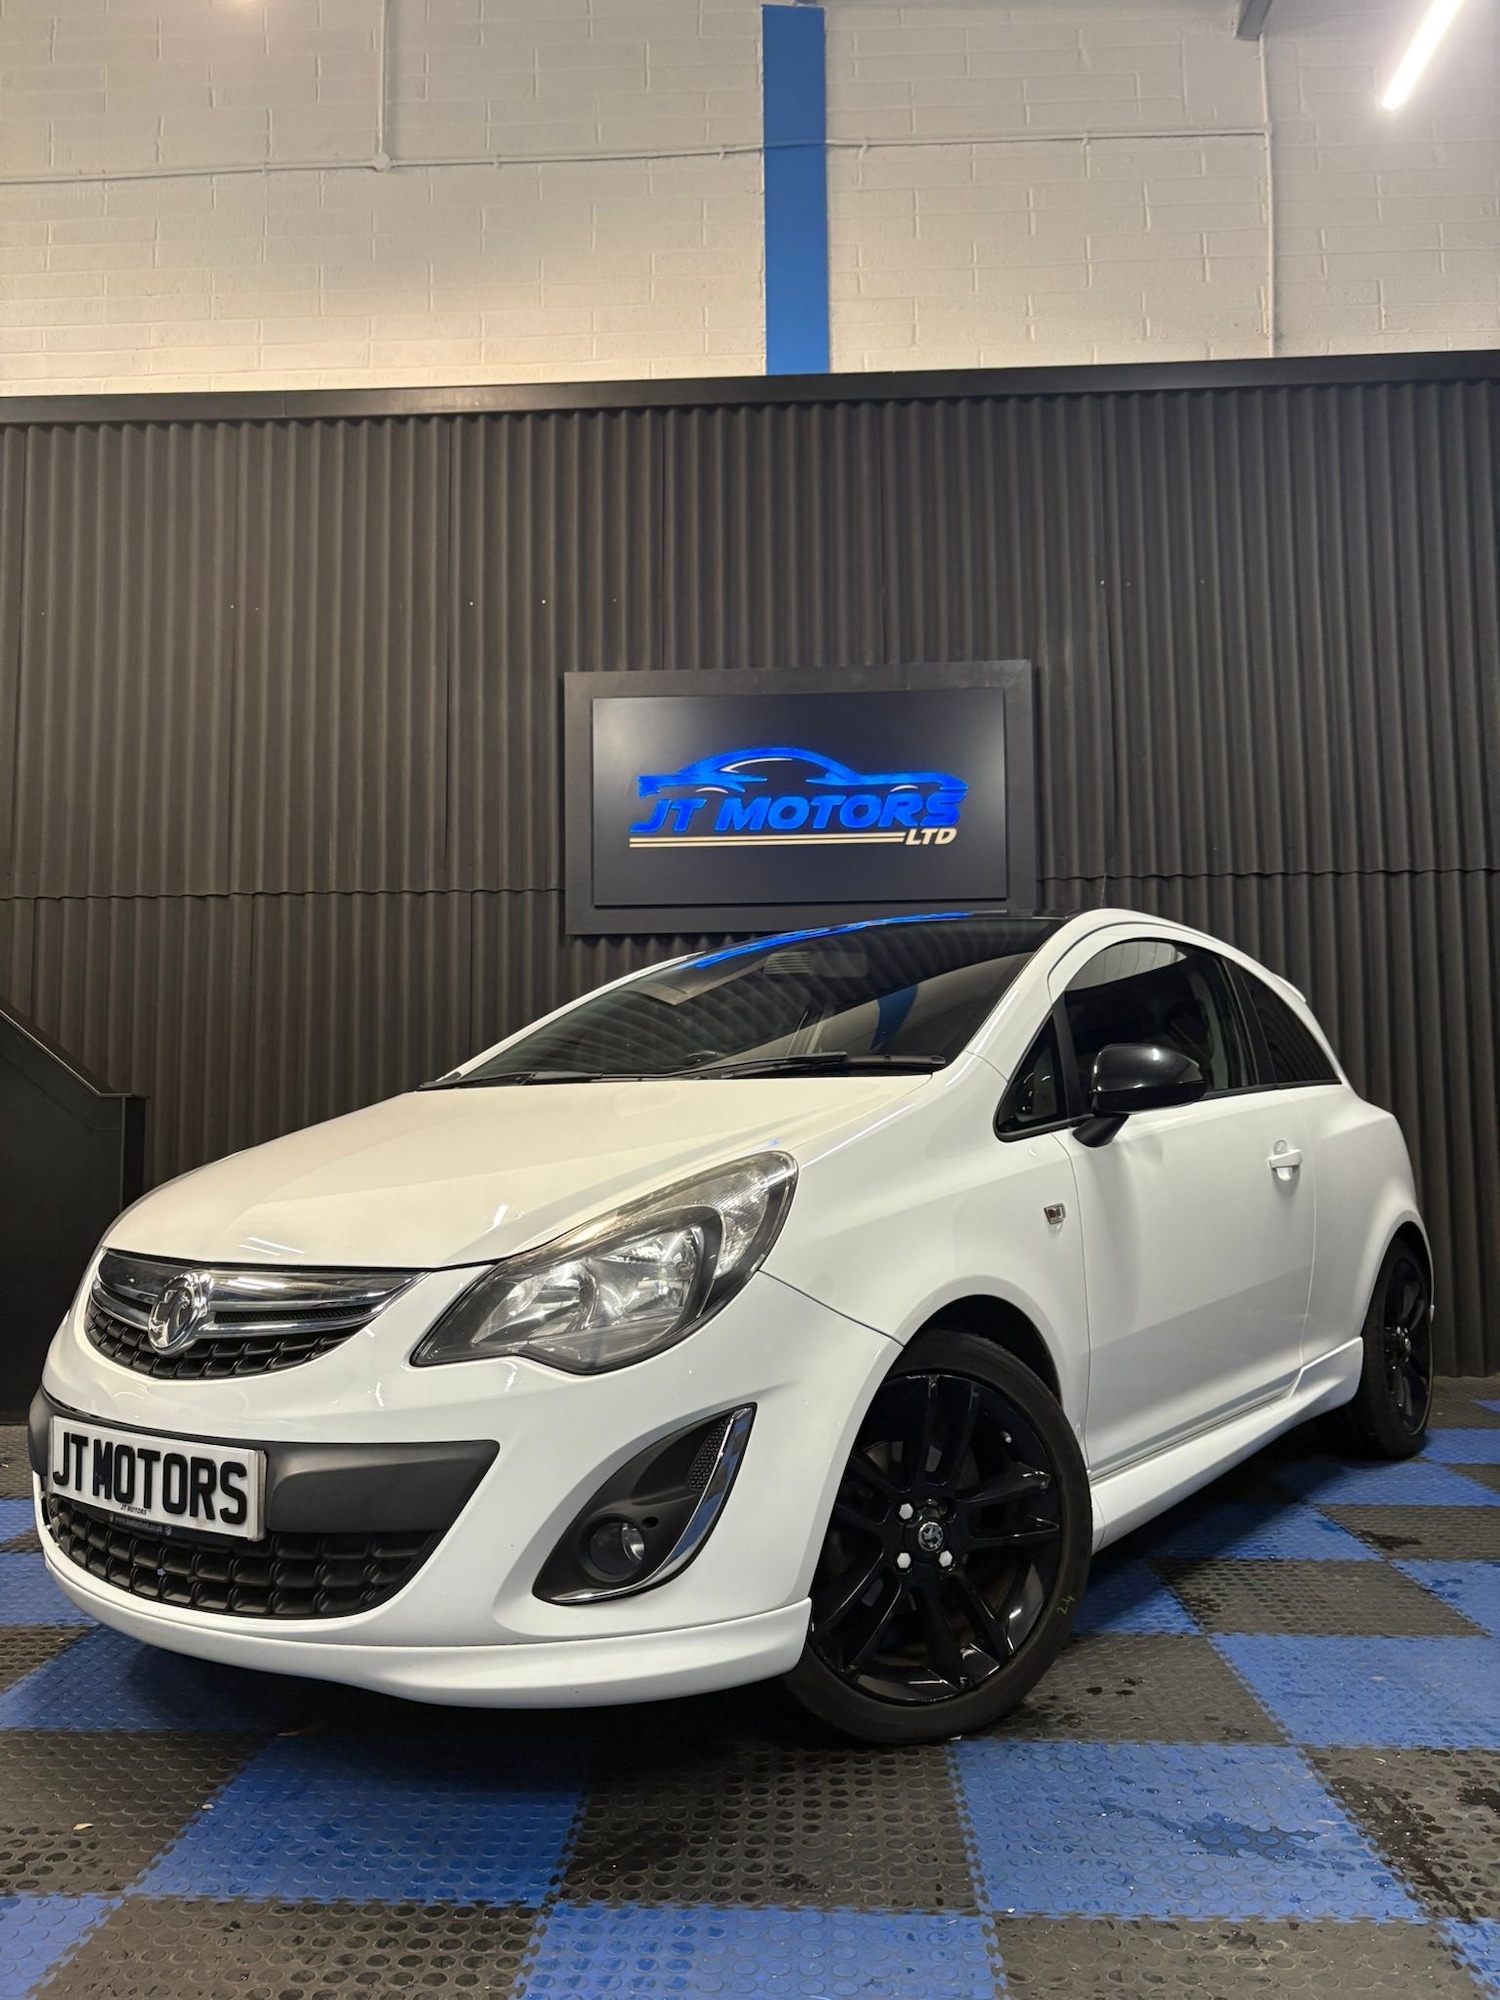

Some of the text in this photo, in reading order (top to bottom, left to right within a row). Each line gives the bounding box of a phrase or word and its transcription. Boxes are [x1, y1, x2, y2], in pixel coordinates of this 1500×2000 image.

[629, 793, 966, 833] JT MOTORS
[904, 828, 957, 846] LTD
[53, 1432, 247, 1524] JT MOTORS
